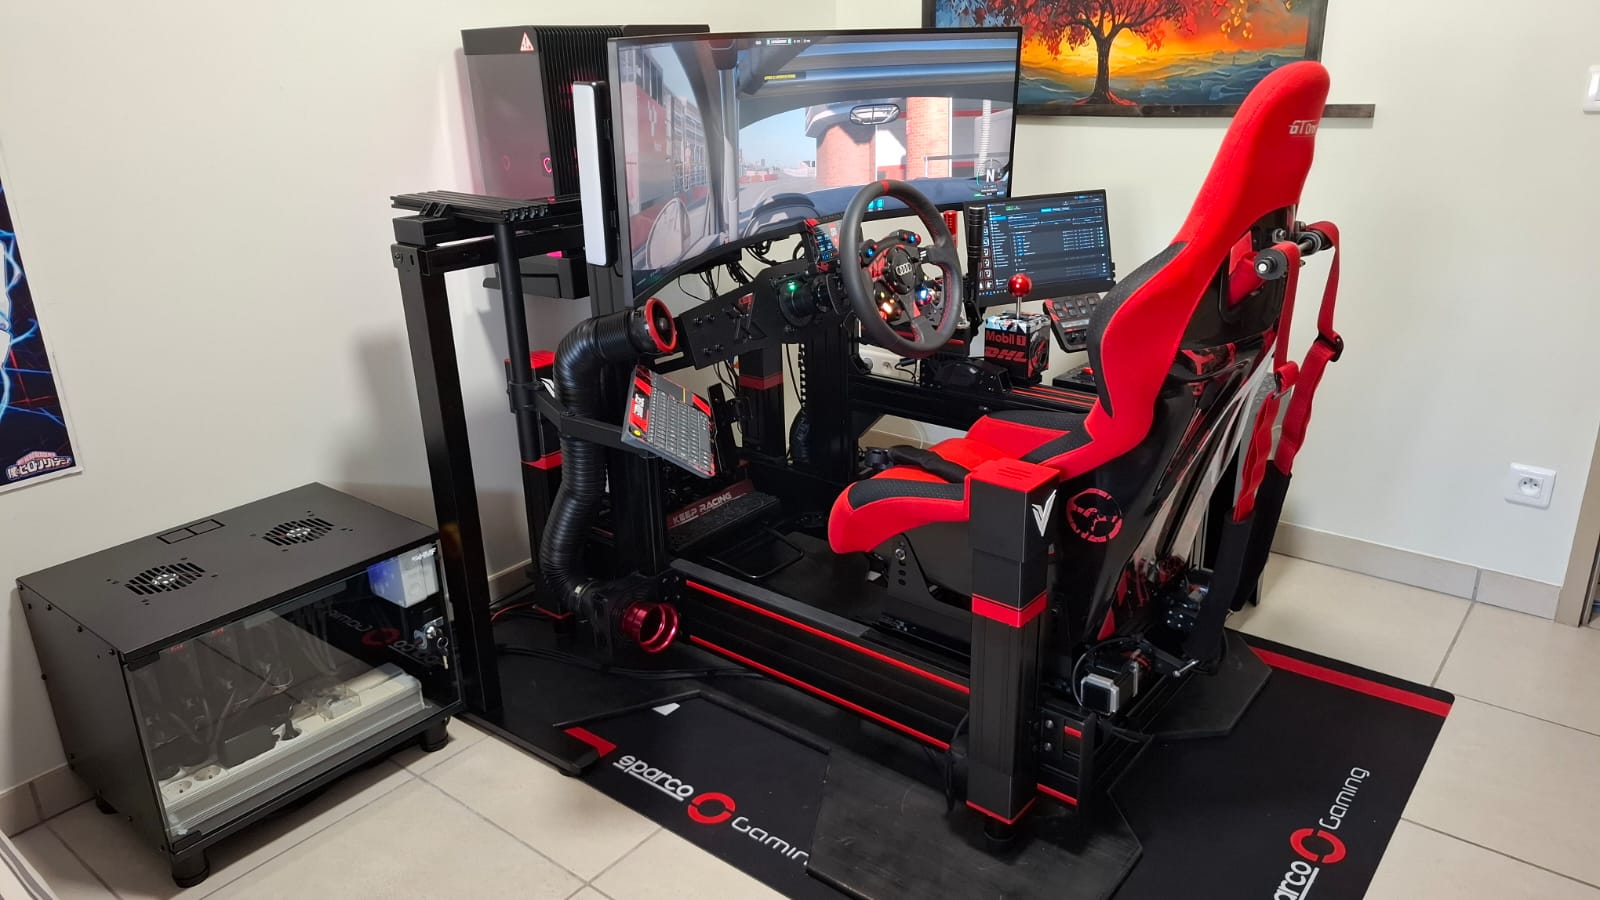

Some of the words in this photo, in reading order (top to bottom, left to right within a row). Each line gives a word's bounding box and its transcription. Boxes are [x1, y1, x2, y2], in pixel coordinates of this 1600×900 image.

[986, 331, 1015, 345] Mobil
[985, 347, 1028, 363] DHL
[672, 508, 698, 524] KEEP
[699, 491, 732, 512] RACING
[614, 755, 694, 800] sparco
[731, 816, 809, 866] Gamin
[1274, 861, 1316, 900] arco
[1319, 767, 1370, 830] Gaming
